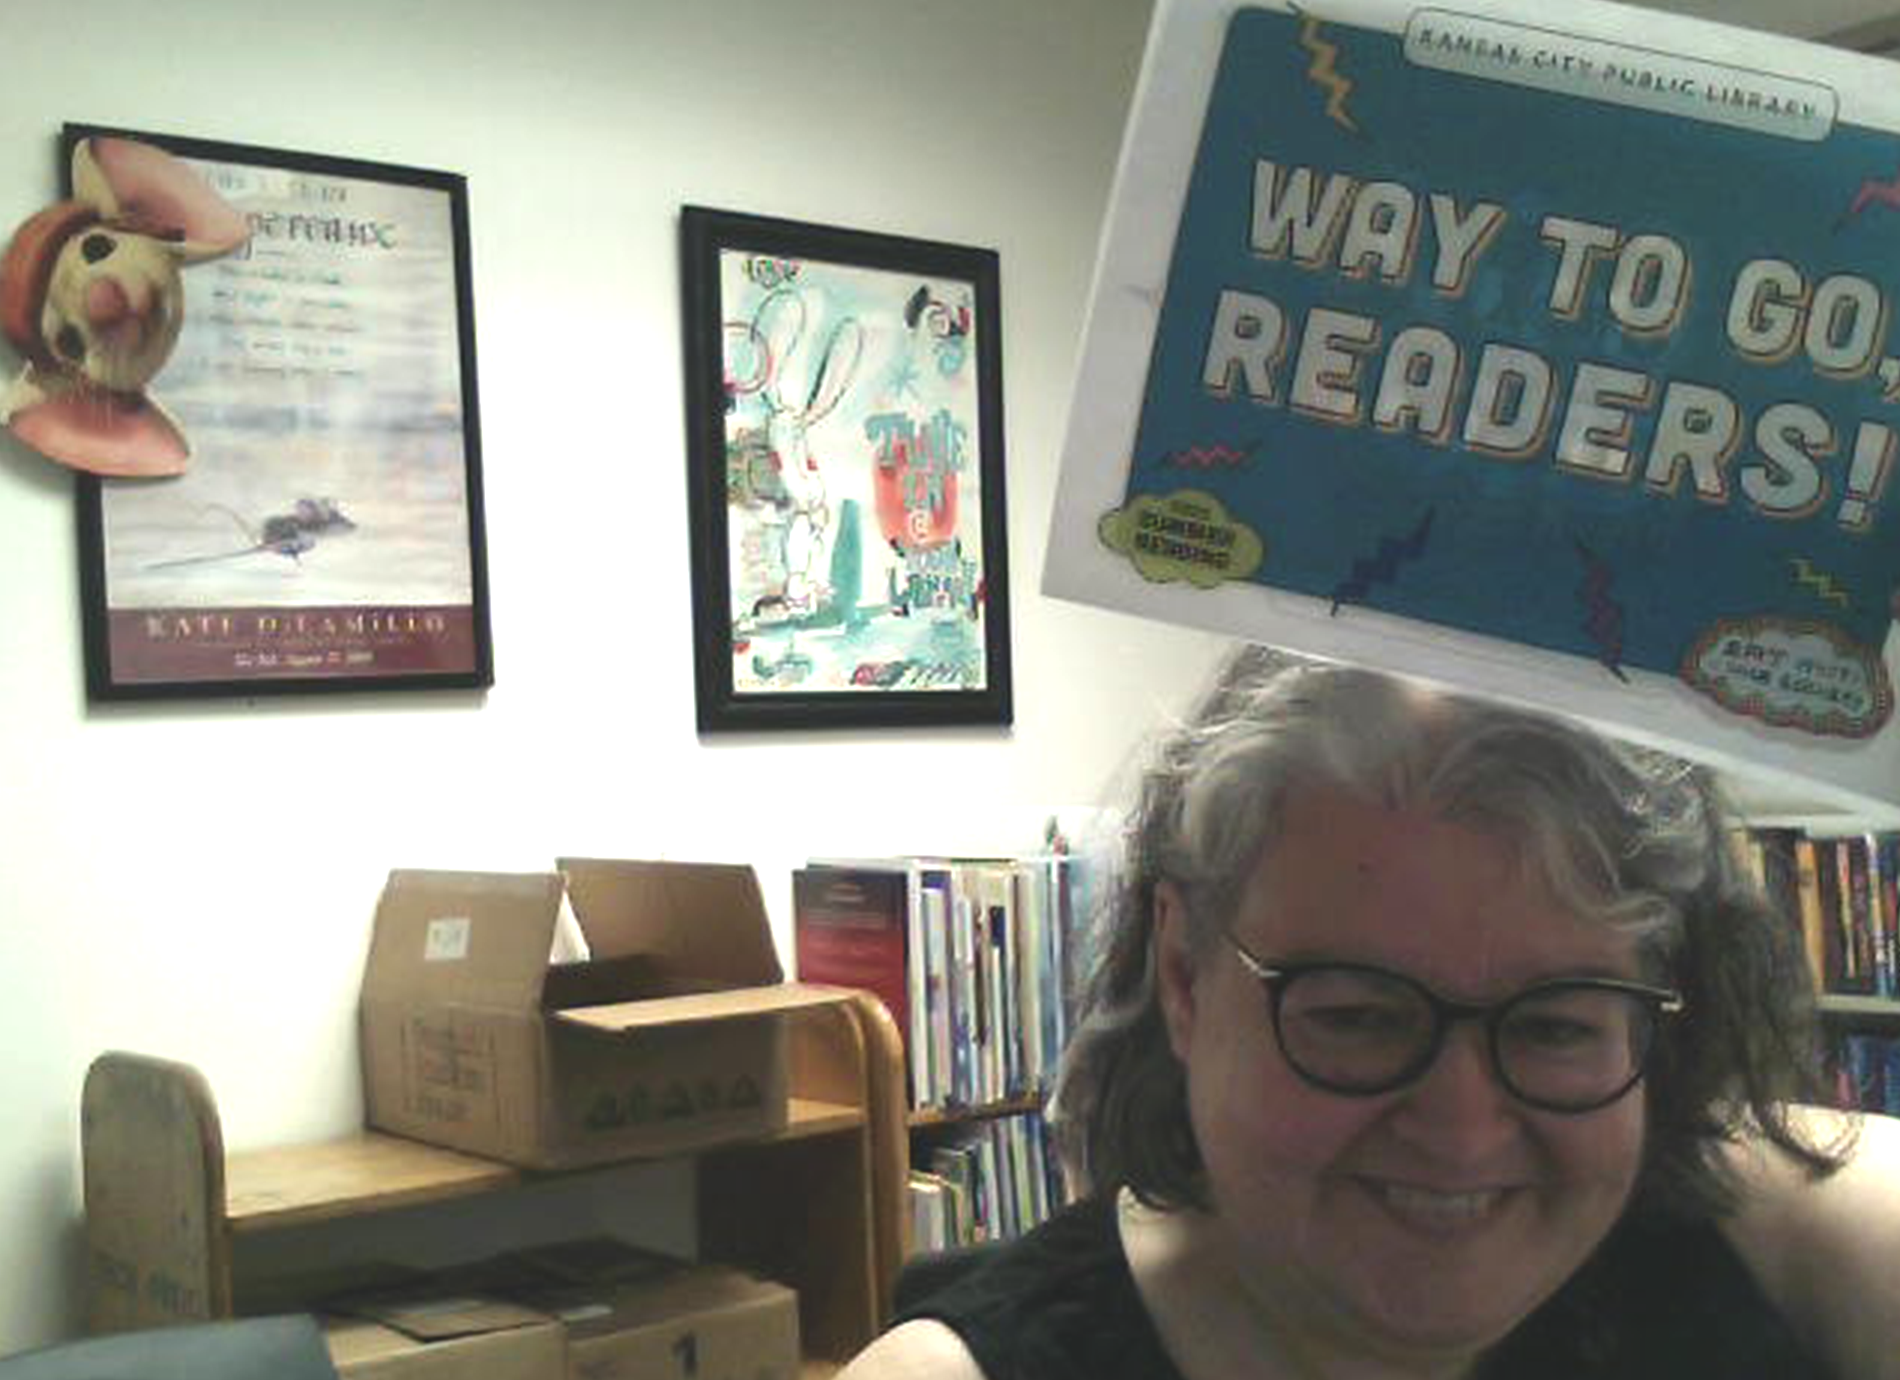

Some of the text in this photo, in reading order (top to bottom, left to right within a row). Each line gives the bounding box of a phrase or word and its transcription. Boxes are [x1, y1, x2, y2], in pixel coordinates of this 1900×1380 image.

[1532, 47, 1594, 79] CITY
[1602, 62, 1697, 98] PUBLIC
[1705, 85, 1817, 120] LIBRARY
[1249, 156, 1900, 403] WAY TO GO,
[1202, 287, 1895, 531] READERS!
